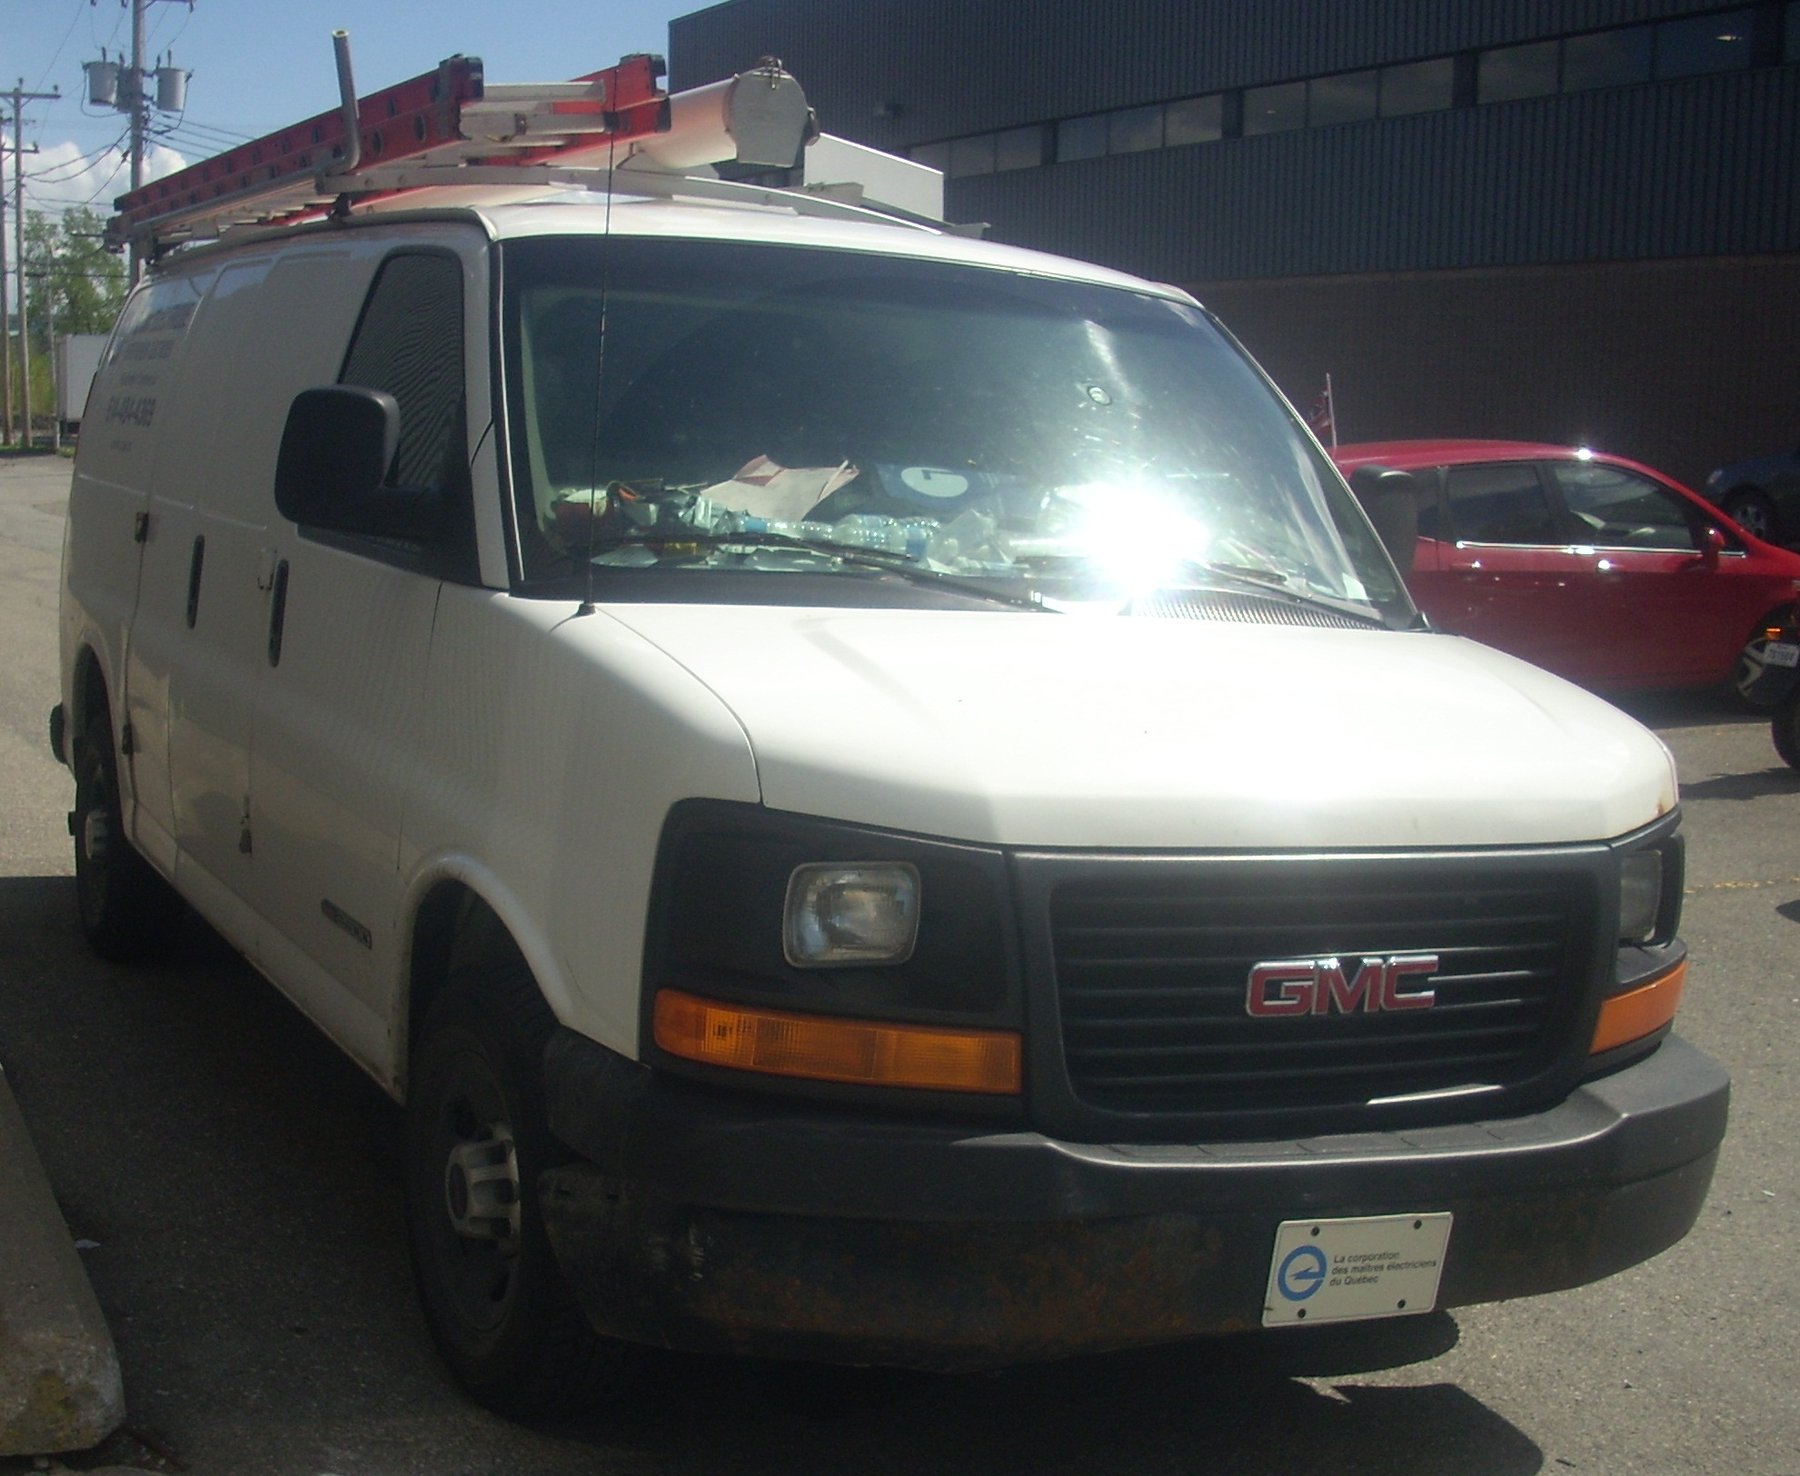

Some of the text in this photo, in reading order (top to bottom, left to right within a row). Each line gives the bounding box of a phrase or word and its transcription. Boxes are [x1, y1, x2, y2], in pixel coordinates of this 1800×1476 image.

[1246, 955, 1439, 1018] GMC
[1333, 1251, 1400, 1264] La corporation
[1331, 1265, 1348, 1275] des
[1329, 1275, 1379, 1286] du Québec
